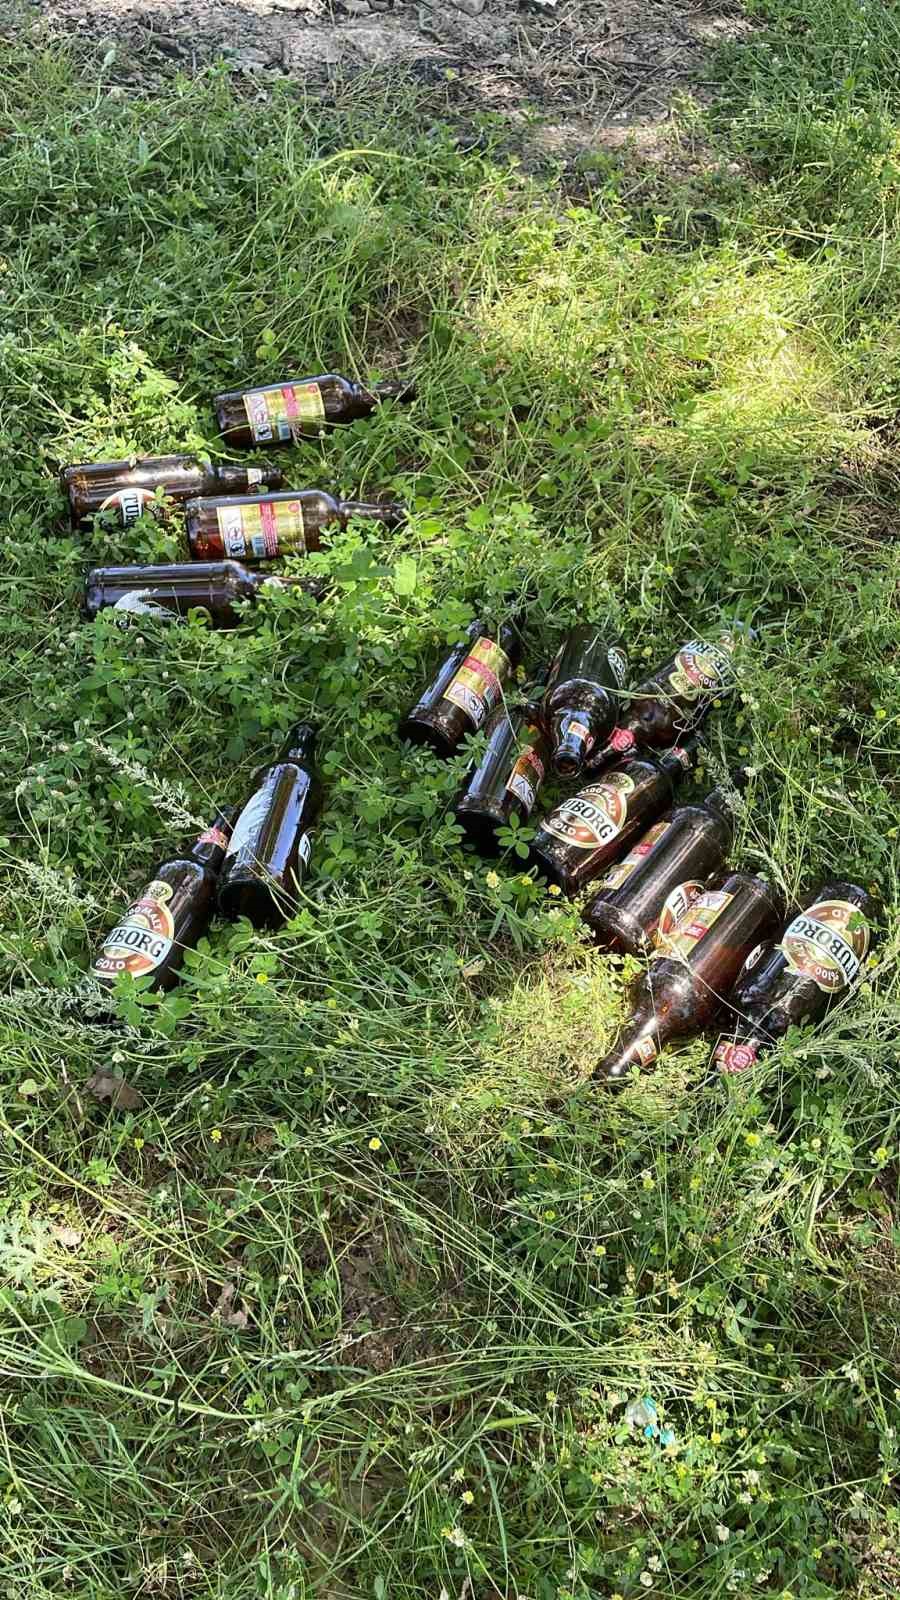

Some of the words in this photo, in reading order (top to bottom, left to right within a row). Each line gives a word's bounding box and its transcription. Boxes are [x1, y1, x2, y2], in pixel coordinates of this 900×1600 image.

[549, 818, 577, 837] GOLD
[560, 799, 613, 839] UBORG
[105, 928, 166, 958] UBORG
[791, 919, 857, 981] TUBORG
[94, 957, 126, 971] GOLD
[815, 966, 840, 981] %100
